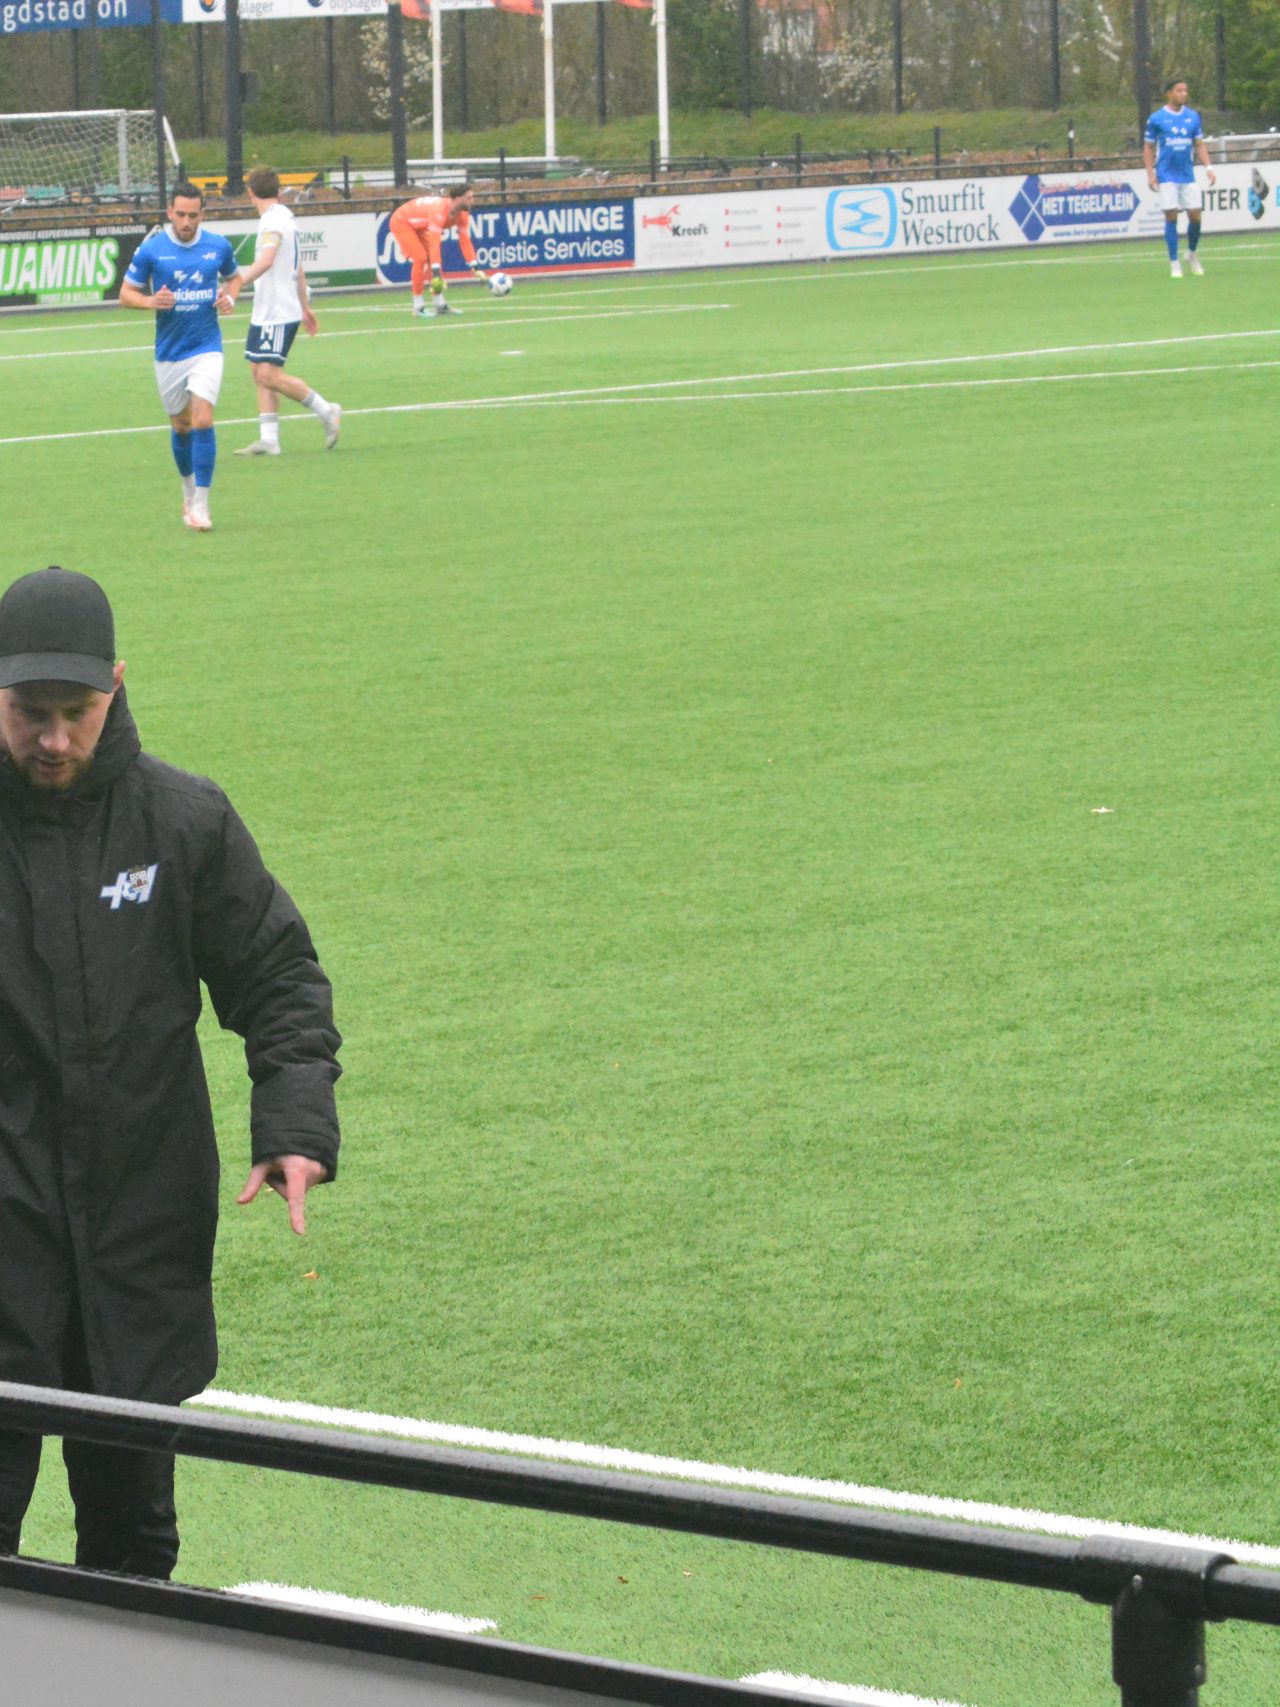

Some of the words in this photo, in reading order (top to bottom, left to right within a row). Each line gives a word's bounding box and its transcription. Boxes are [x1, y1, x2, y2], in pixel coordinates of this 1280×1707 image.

[901, 183, 984, 215] Smurfit
[1042, 196, 1064, 216] HET
[1067, 192, 1134, 214] TEGELPLEIN
[506, 205, 624, 236] WANINGE
[672, 223, 708, 237] Kreeft
[902, 214, 1001, 246] Westrock
[543, 237, 624, 259] Services
